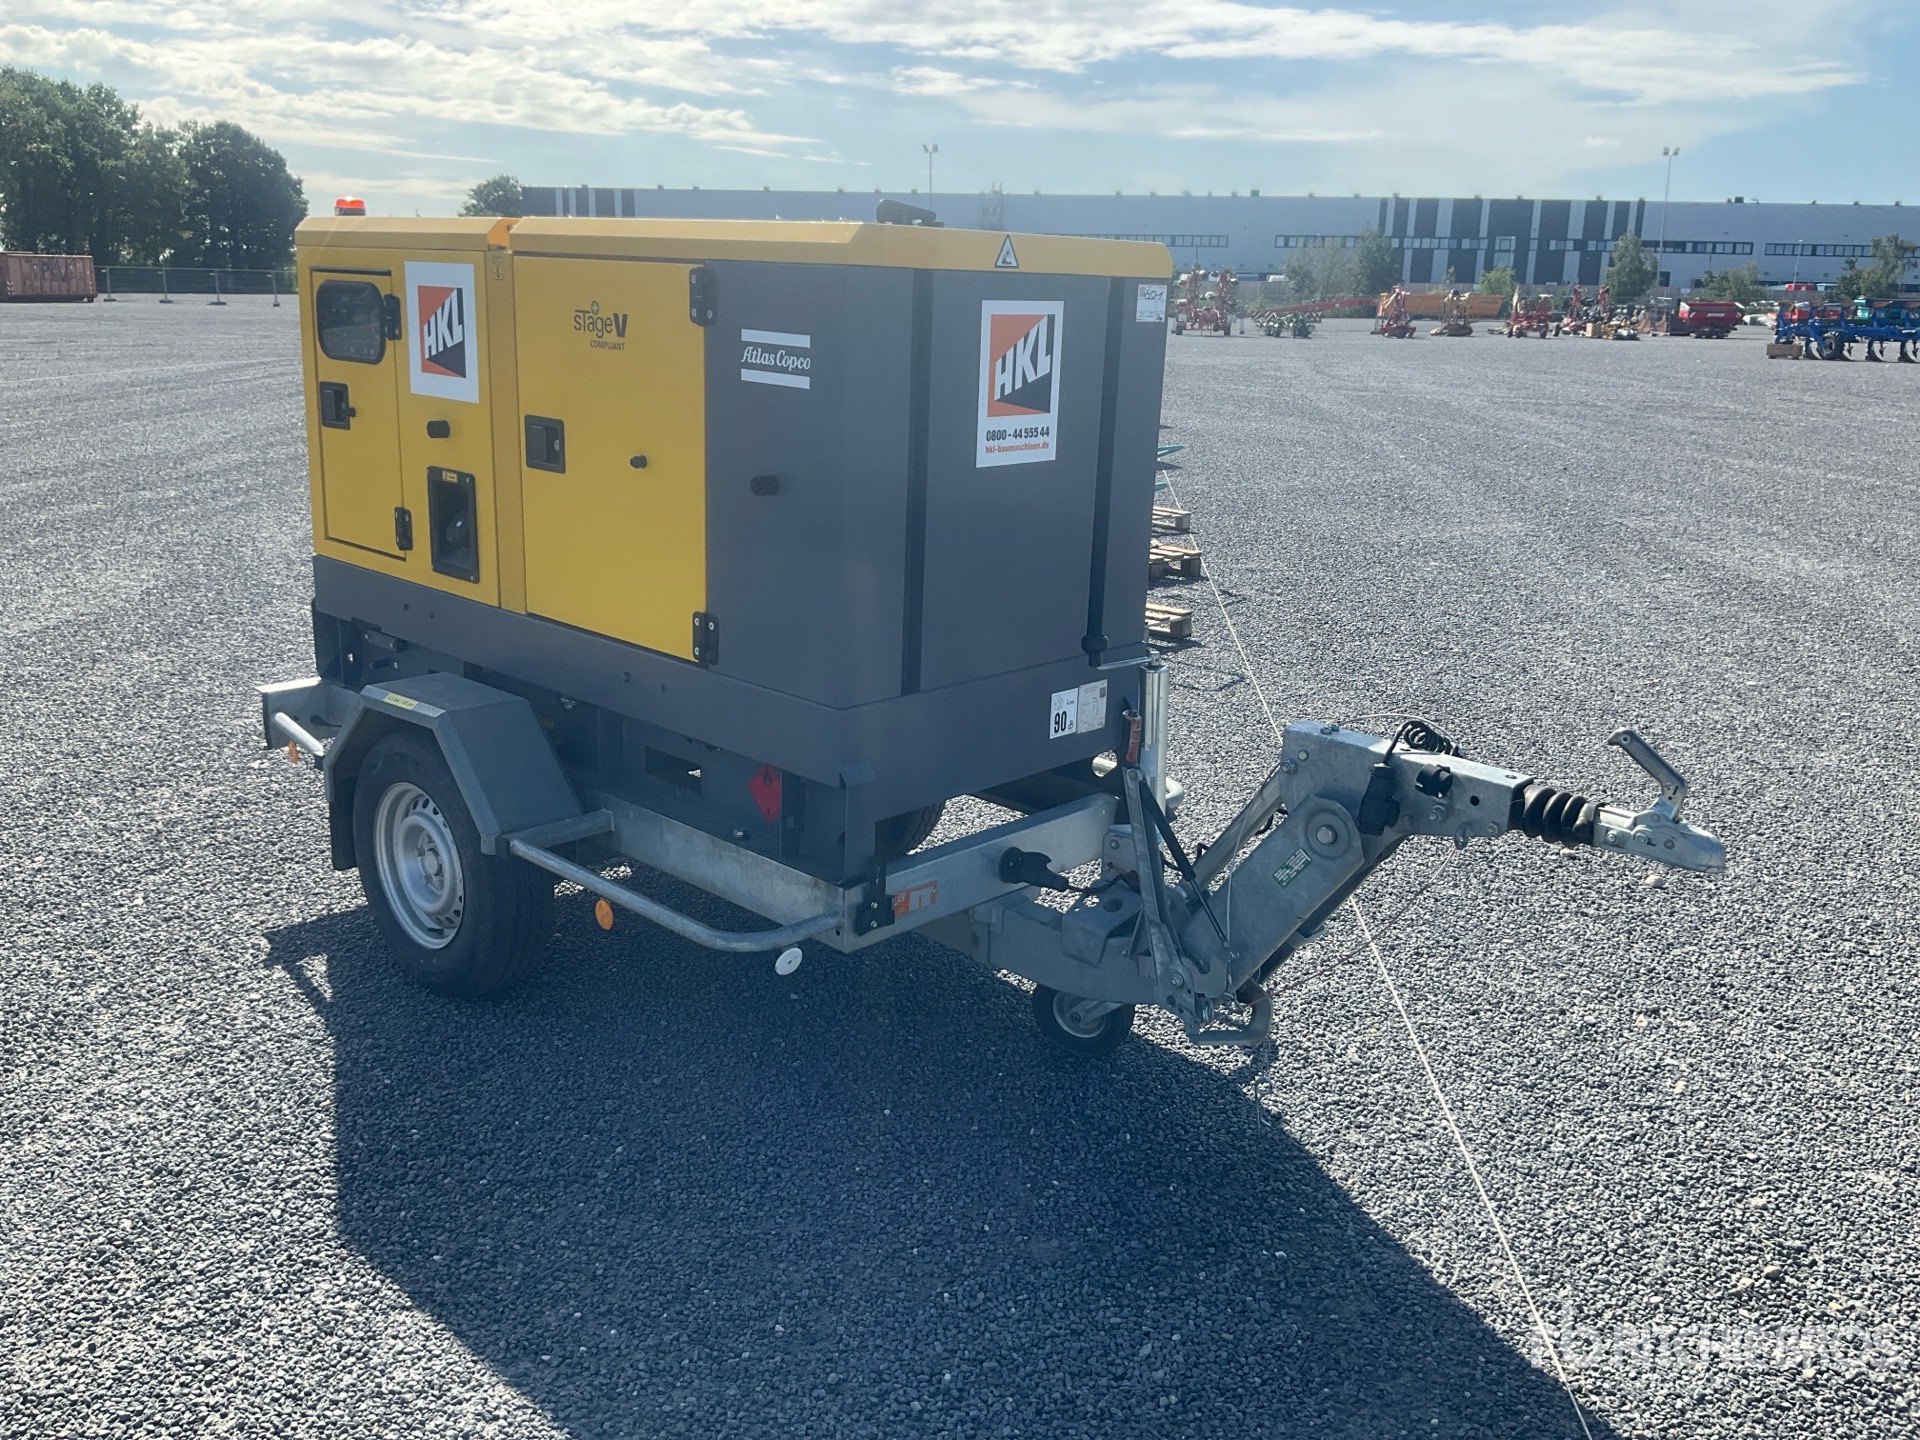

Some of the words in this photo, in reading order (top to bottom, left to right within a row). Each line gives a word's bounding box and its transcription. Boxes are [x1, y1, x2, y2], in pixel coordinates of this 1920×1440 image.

[424, 288, 463, 360] HKL
[590, 339, 625, 351] COMPLIANT
[740, 346, 775, 366] Atlas
[775, 349, 811, 371] Copco
[994, 314, 1051, 401] HKL
[986, 429, 1007, 442] 0800
[1012, 428, 1023, 440] 44
[1023, 427, 1039, 439] 555
[1039, 426, 1050, 438] 44
[985, 441, 1050, 454] hkl-baumaschinen.de
[1054, 710, 1067, 734] 90
